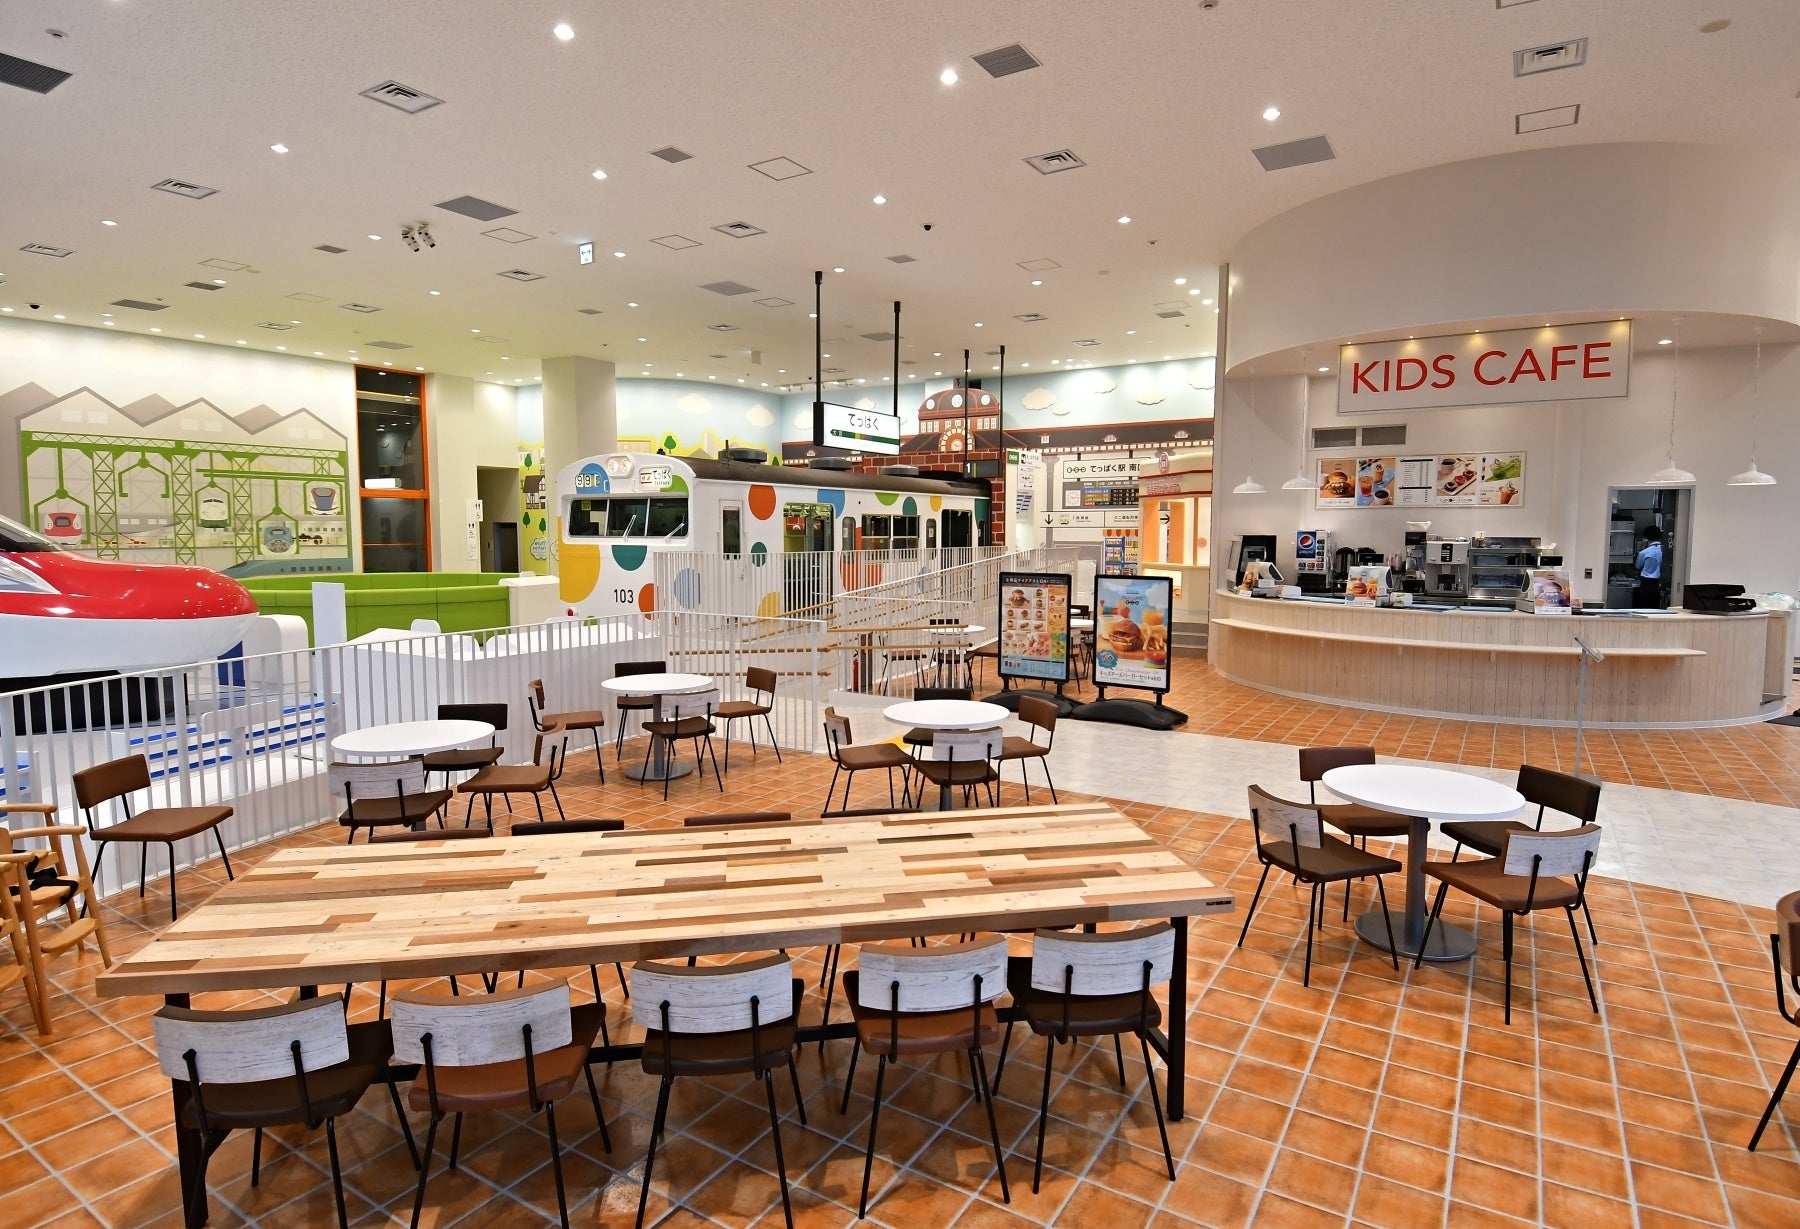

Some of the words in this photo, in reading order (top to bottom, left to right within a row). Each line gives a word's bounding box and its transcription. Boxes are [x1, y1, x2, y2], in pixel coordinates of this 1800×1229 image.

[1352, 354, 1456, 394] KIDS
[1473, 341, 1612, 385] CAFE
[966, 462, 971, 474] 1
[613, 588, 634, 604] 103
